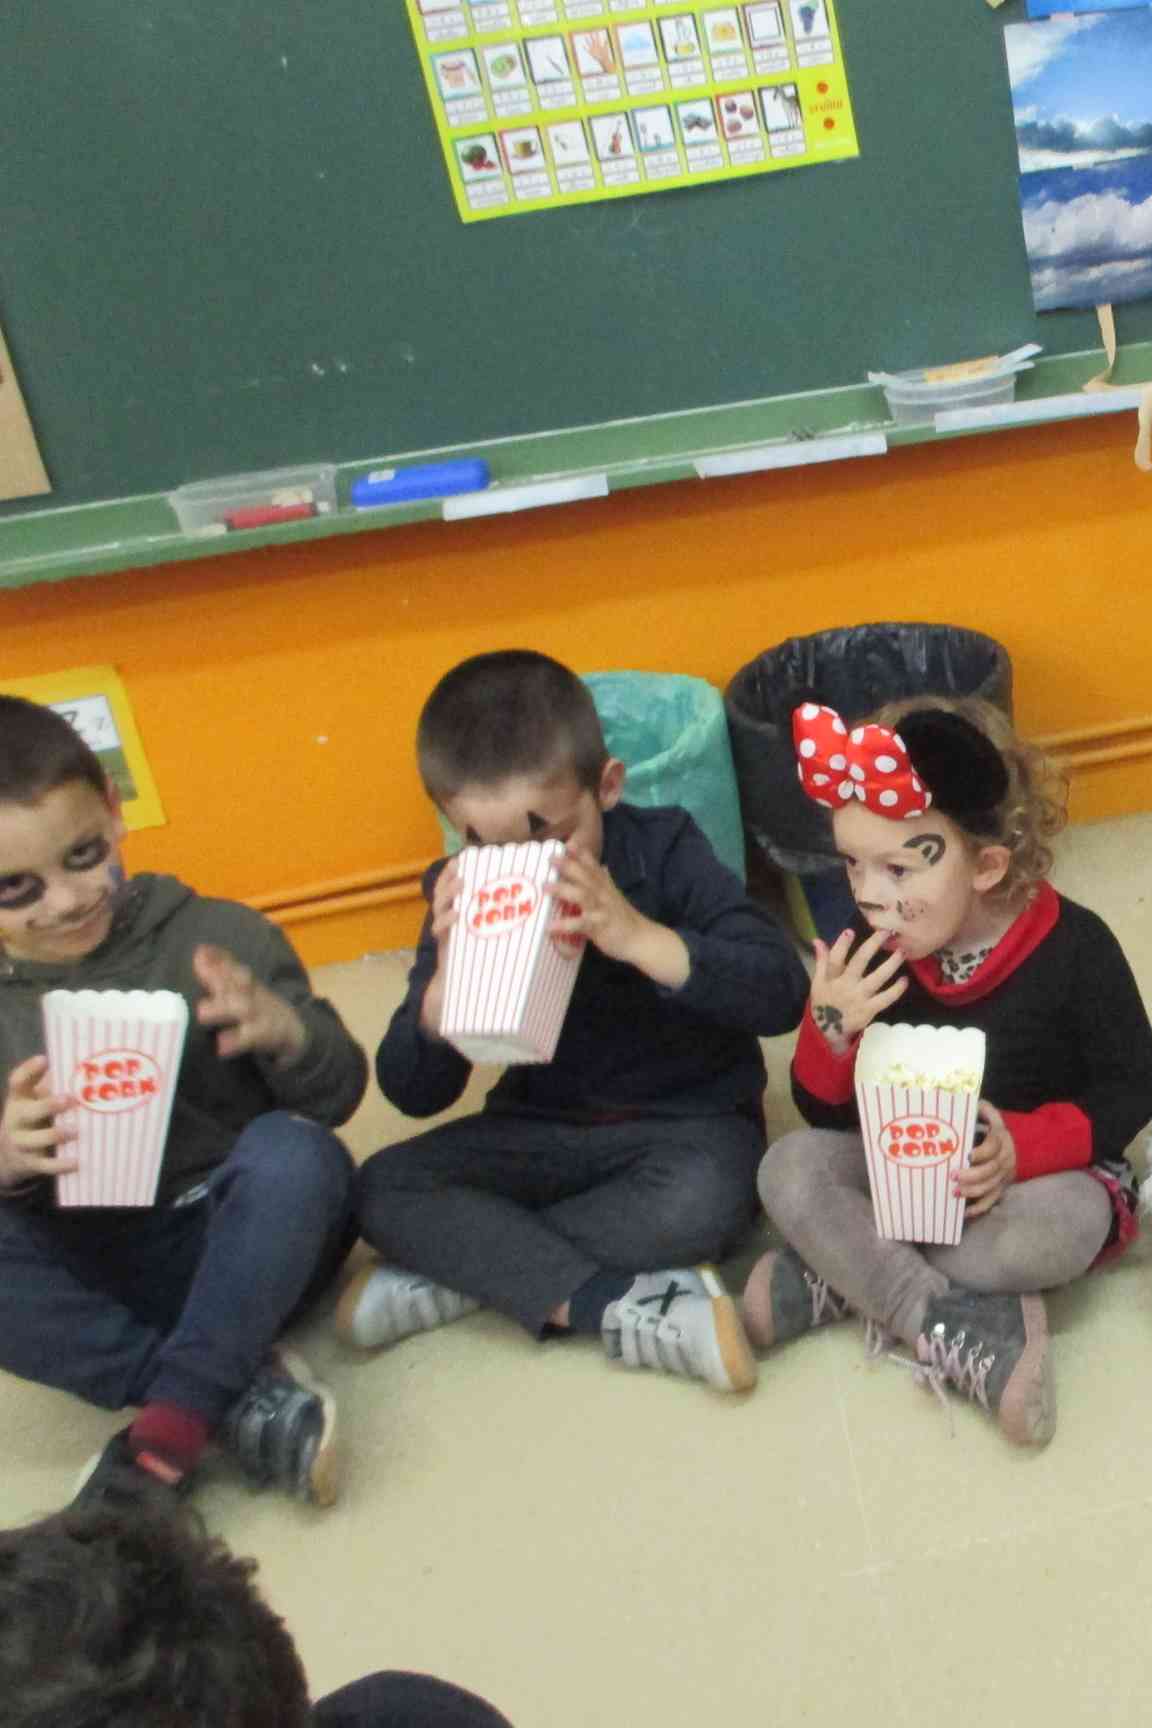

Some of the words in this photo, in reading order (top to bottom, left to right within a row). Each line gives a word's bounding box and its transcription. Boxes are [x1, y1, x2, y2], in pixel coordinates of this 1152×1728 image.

[478, 883, 523, 904] POP
[473, 902, 531, 928] CORN
[80, 1059, 140, 1080] POP
[82, 1079, 156, 1102] CORN
[889, 1123, 941, 1141] POP
[889, 1140, 956, 1158] CORN
